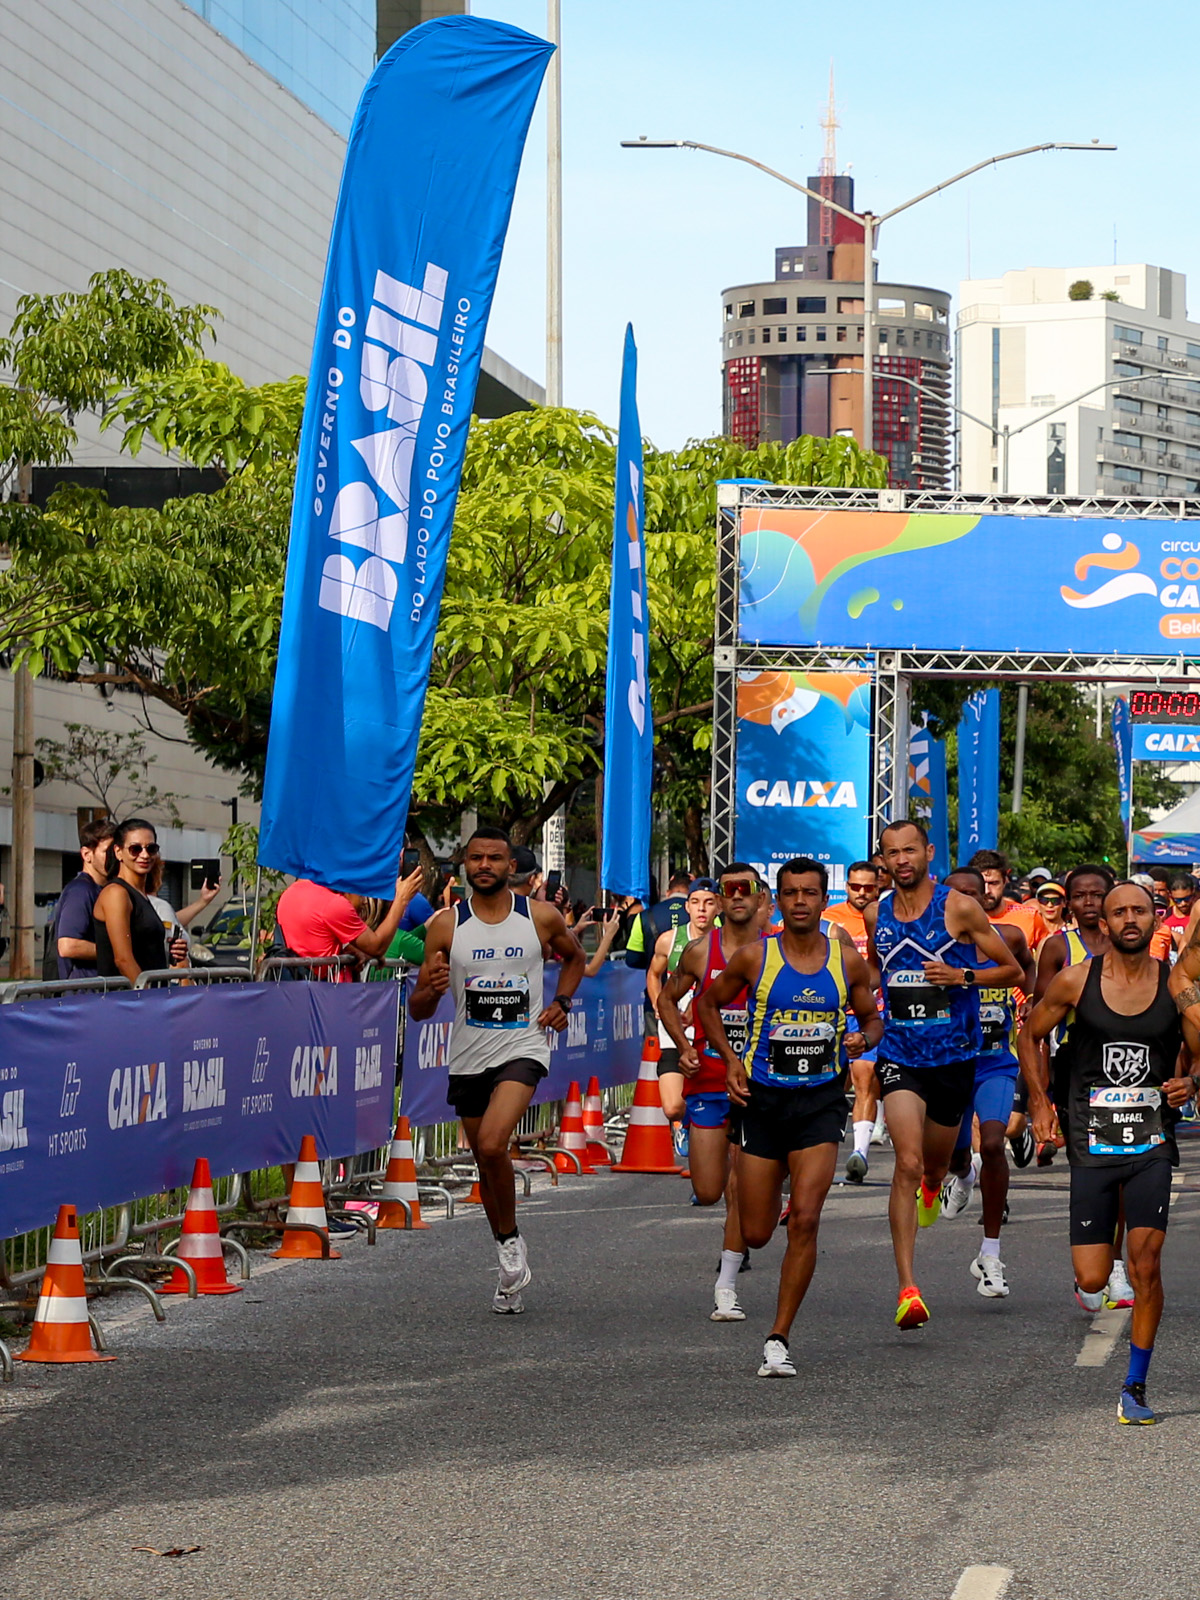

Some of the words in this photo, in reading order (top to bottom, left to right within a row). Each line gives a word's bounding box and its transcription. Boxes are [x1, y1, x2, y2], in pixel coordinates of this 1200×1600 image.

[441, 297, 471, 416] BRASILEIRO
[314, 366, 344, 516] GOVERNO
[332, 306, 357, 350] DO
[318, 262, 449, 632] BRASIL
[427, 423, 451, 481] POVO
[420, 489, 437, 520] DO
[415, 527, 430, 584] LADO
[411, 591, 425, 622] DO
[745, 780, 858, 808] CAIXA
[478, 980, 513, 989] CAIXA
[478, 996, 520, 1005] ANDERSON
[793, 995, 826, 1004] CASSEMS
[908, 1004, 927, 1018] 12
[492, 1007, 503, 1021] 4
[783, 1028, 821, 1038] CAIXA
[784, 1045, 825, 1056] GLENISON
[290, 1045, 338, 1098] CAIXA
[797, 1058, 810, 1074] 8
[108, 1061, 168, 1131] CAIXA
[182, 1056, 227, 1113] BRASIL
[250, 1093, 273, 1115] SPORTS
[1104, 1092, 1145, 1103] CAIXA
[1112, 1112, 1144, 1124] RAFAEL
[48, 1133, 59, 1158] HT
[59, 1127, 87, 1155] SPORTS
[1122, 1127, 1135, 1144] 5
